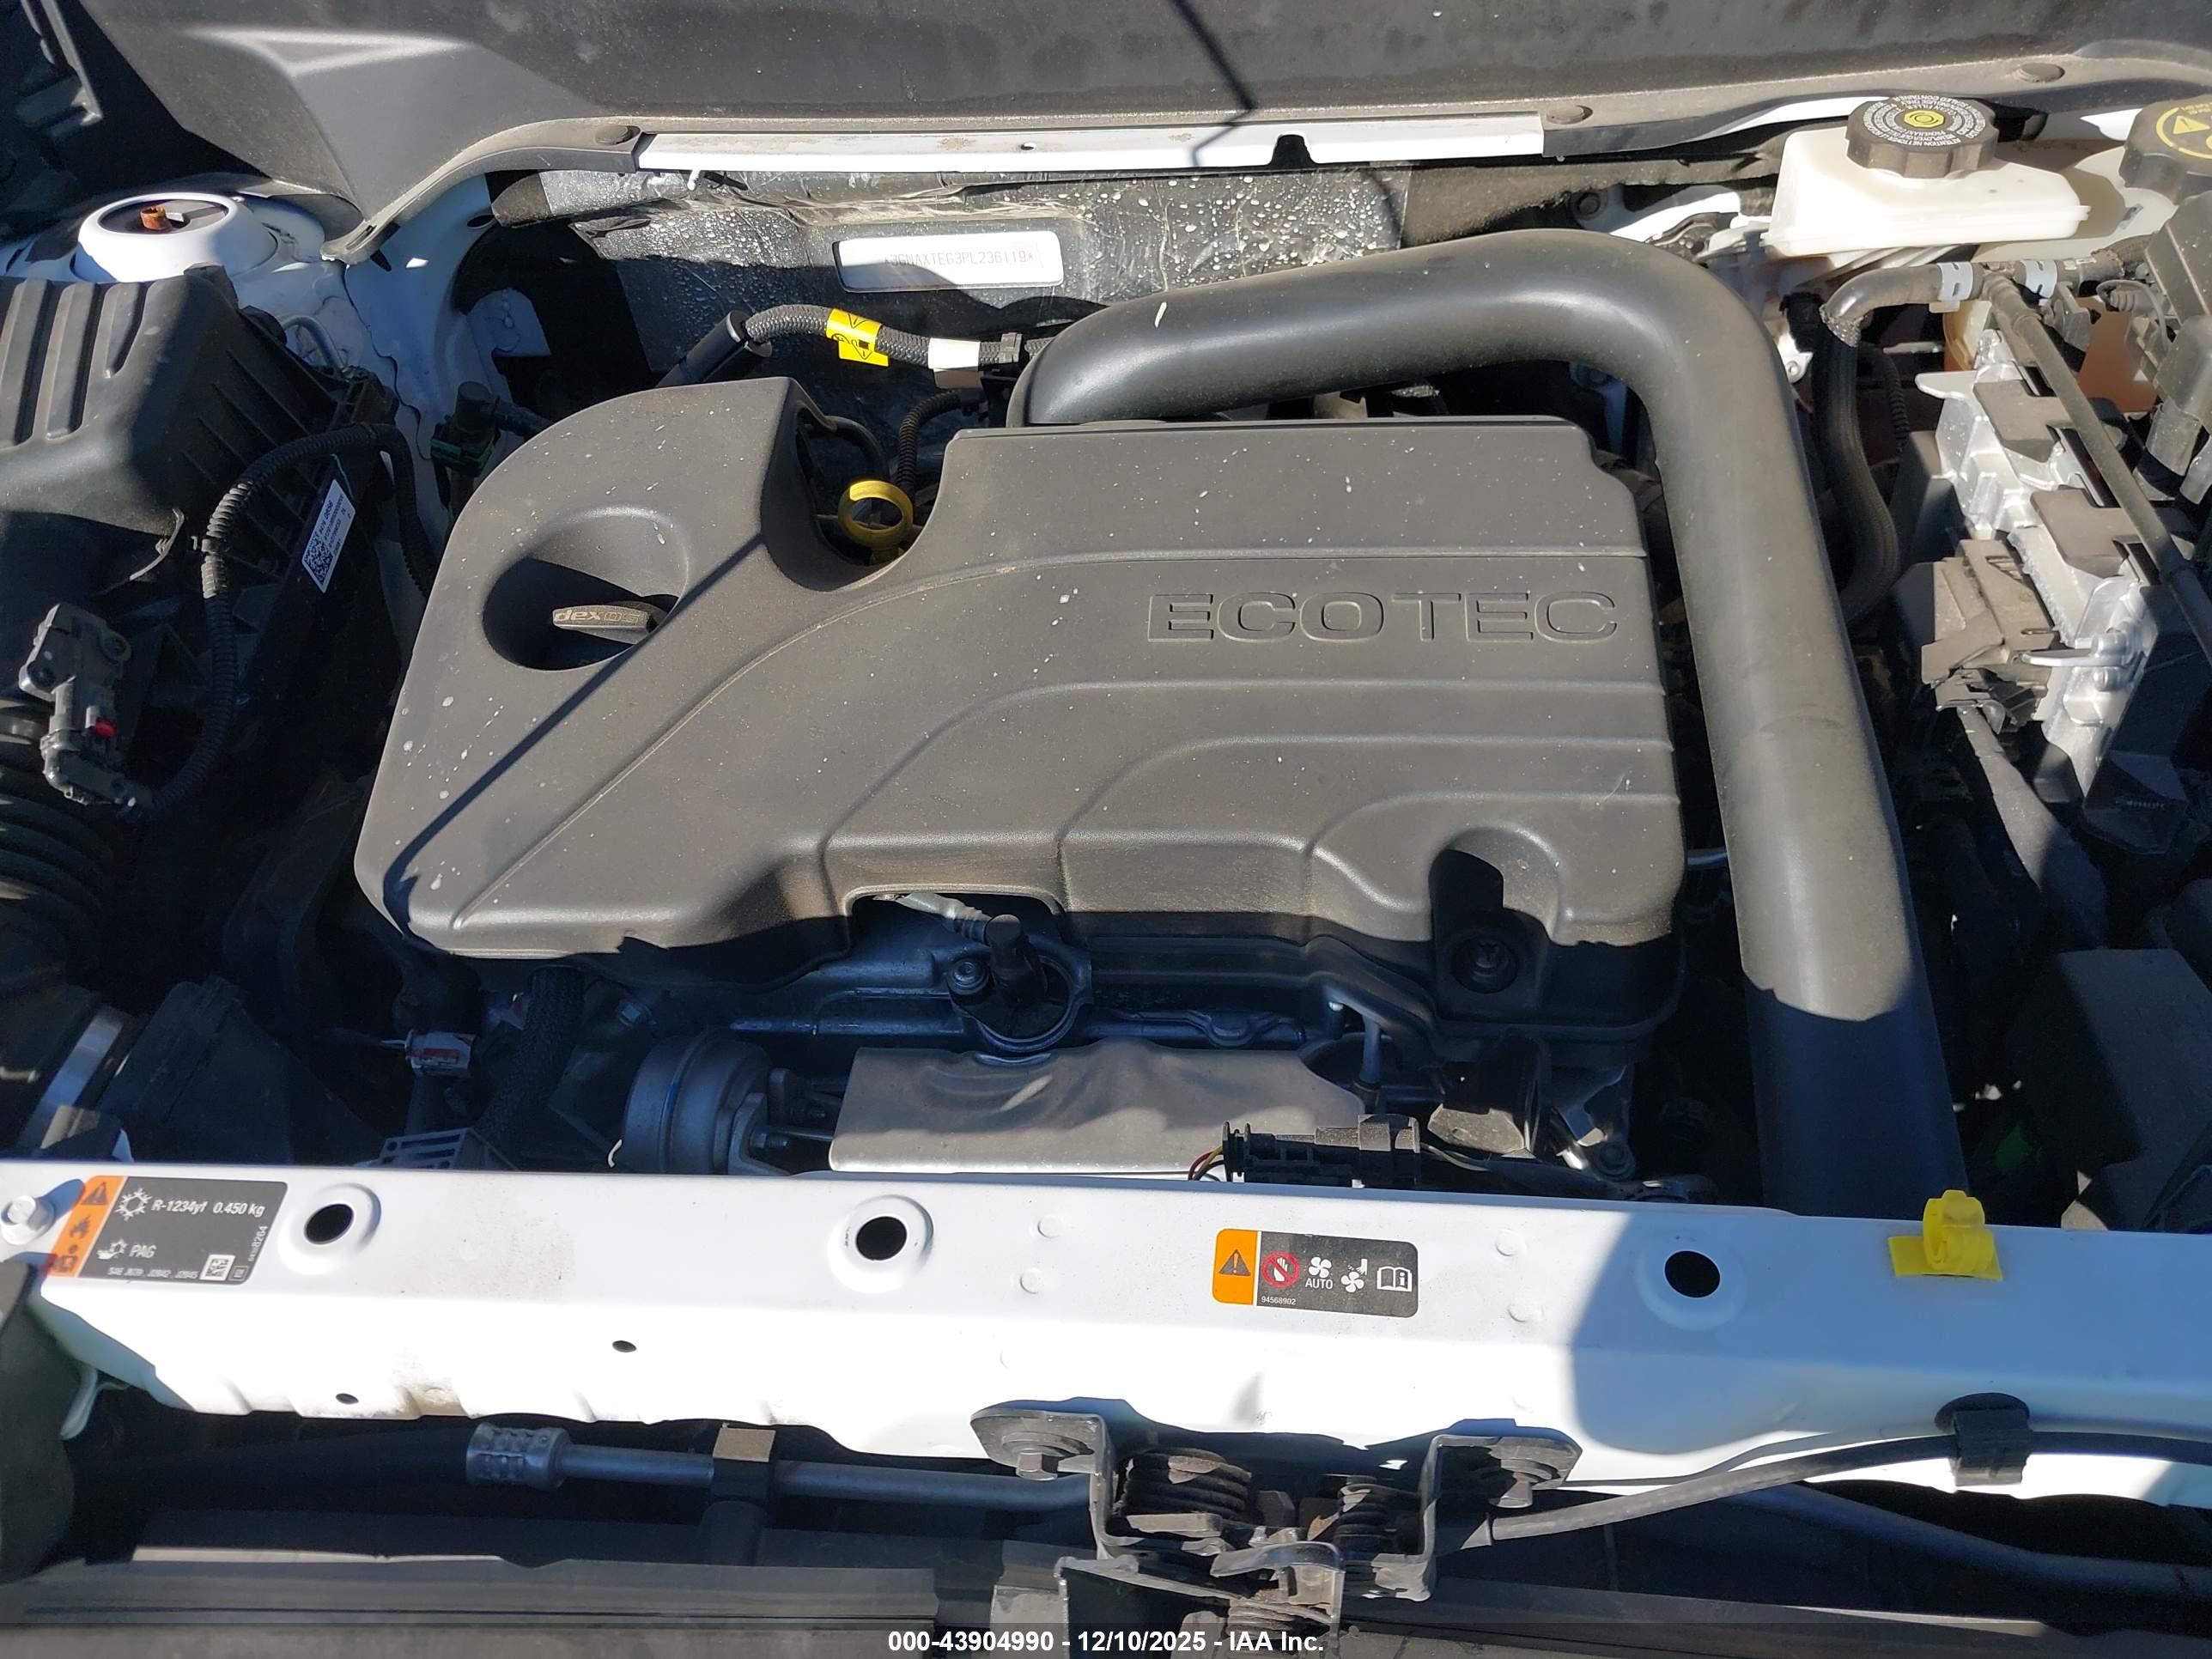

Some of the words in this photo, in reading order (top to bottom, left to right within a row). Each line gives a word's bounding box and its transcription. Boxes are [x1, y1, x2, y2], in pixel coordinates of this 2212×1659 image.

[1147, 592, 1620, 644] ECOTEC
[151, 1200, 208, 1214] R-1234yf
[212, 1202, 247, 1215] 0.450
[248, 1203, 266, 1218] kg
[129, 1244, 157, 1259] PAG
[1304, 1279, 1334, 1290] AUTO
[1261, 1295, 1297, 1306] 94568902
